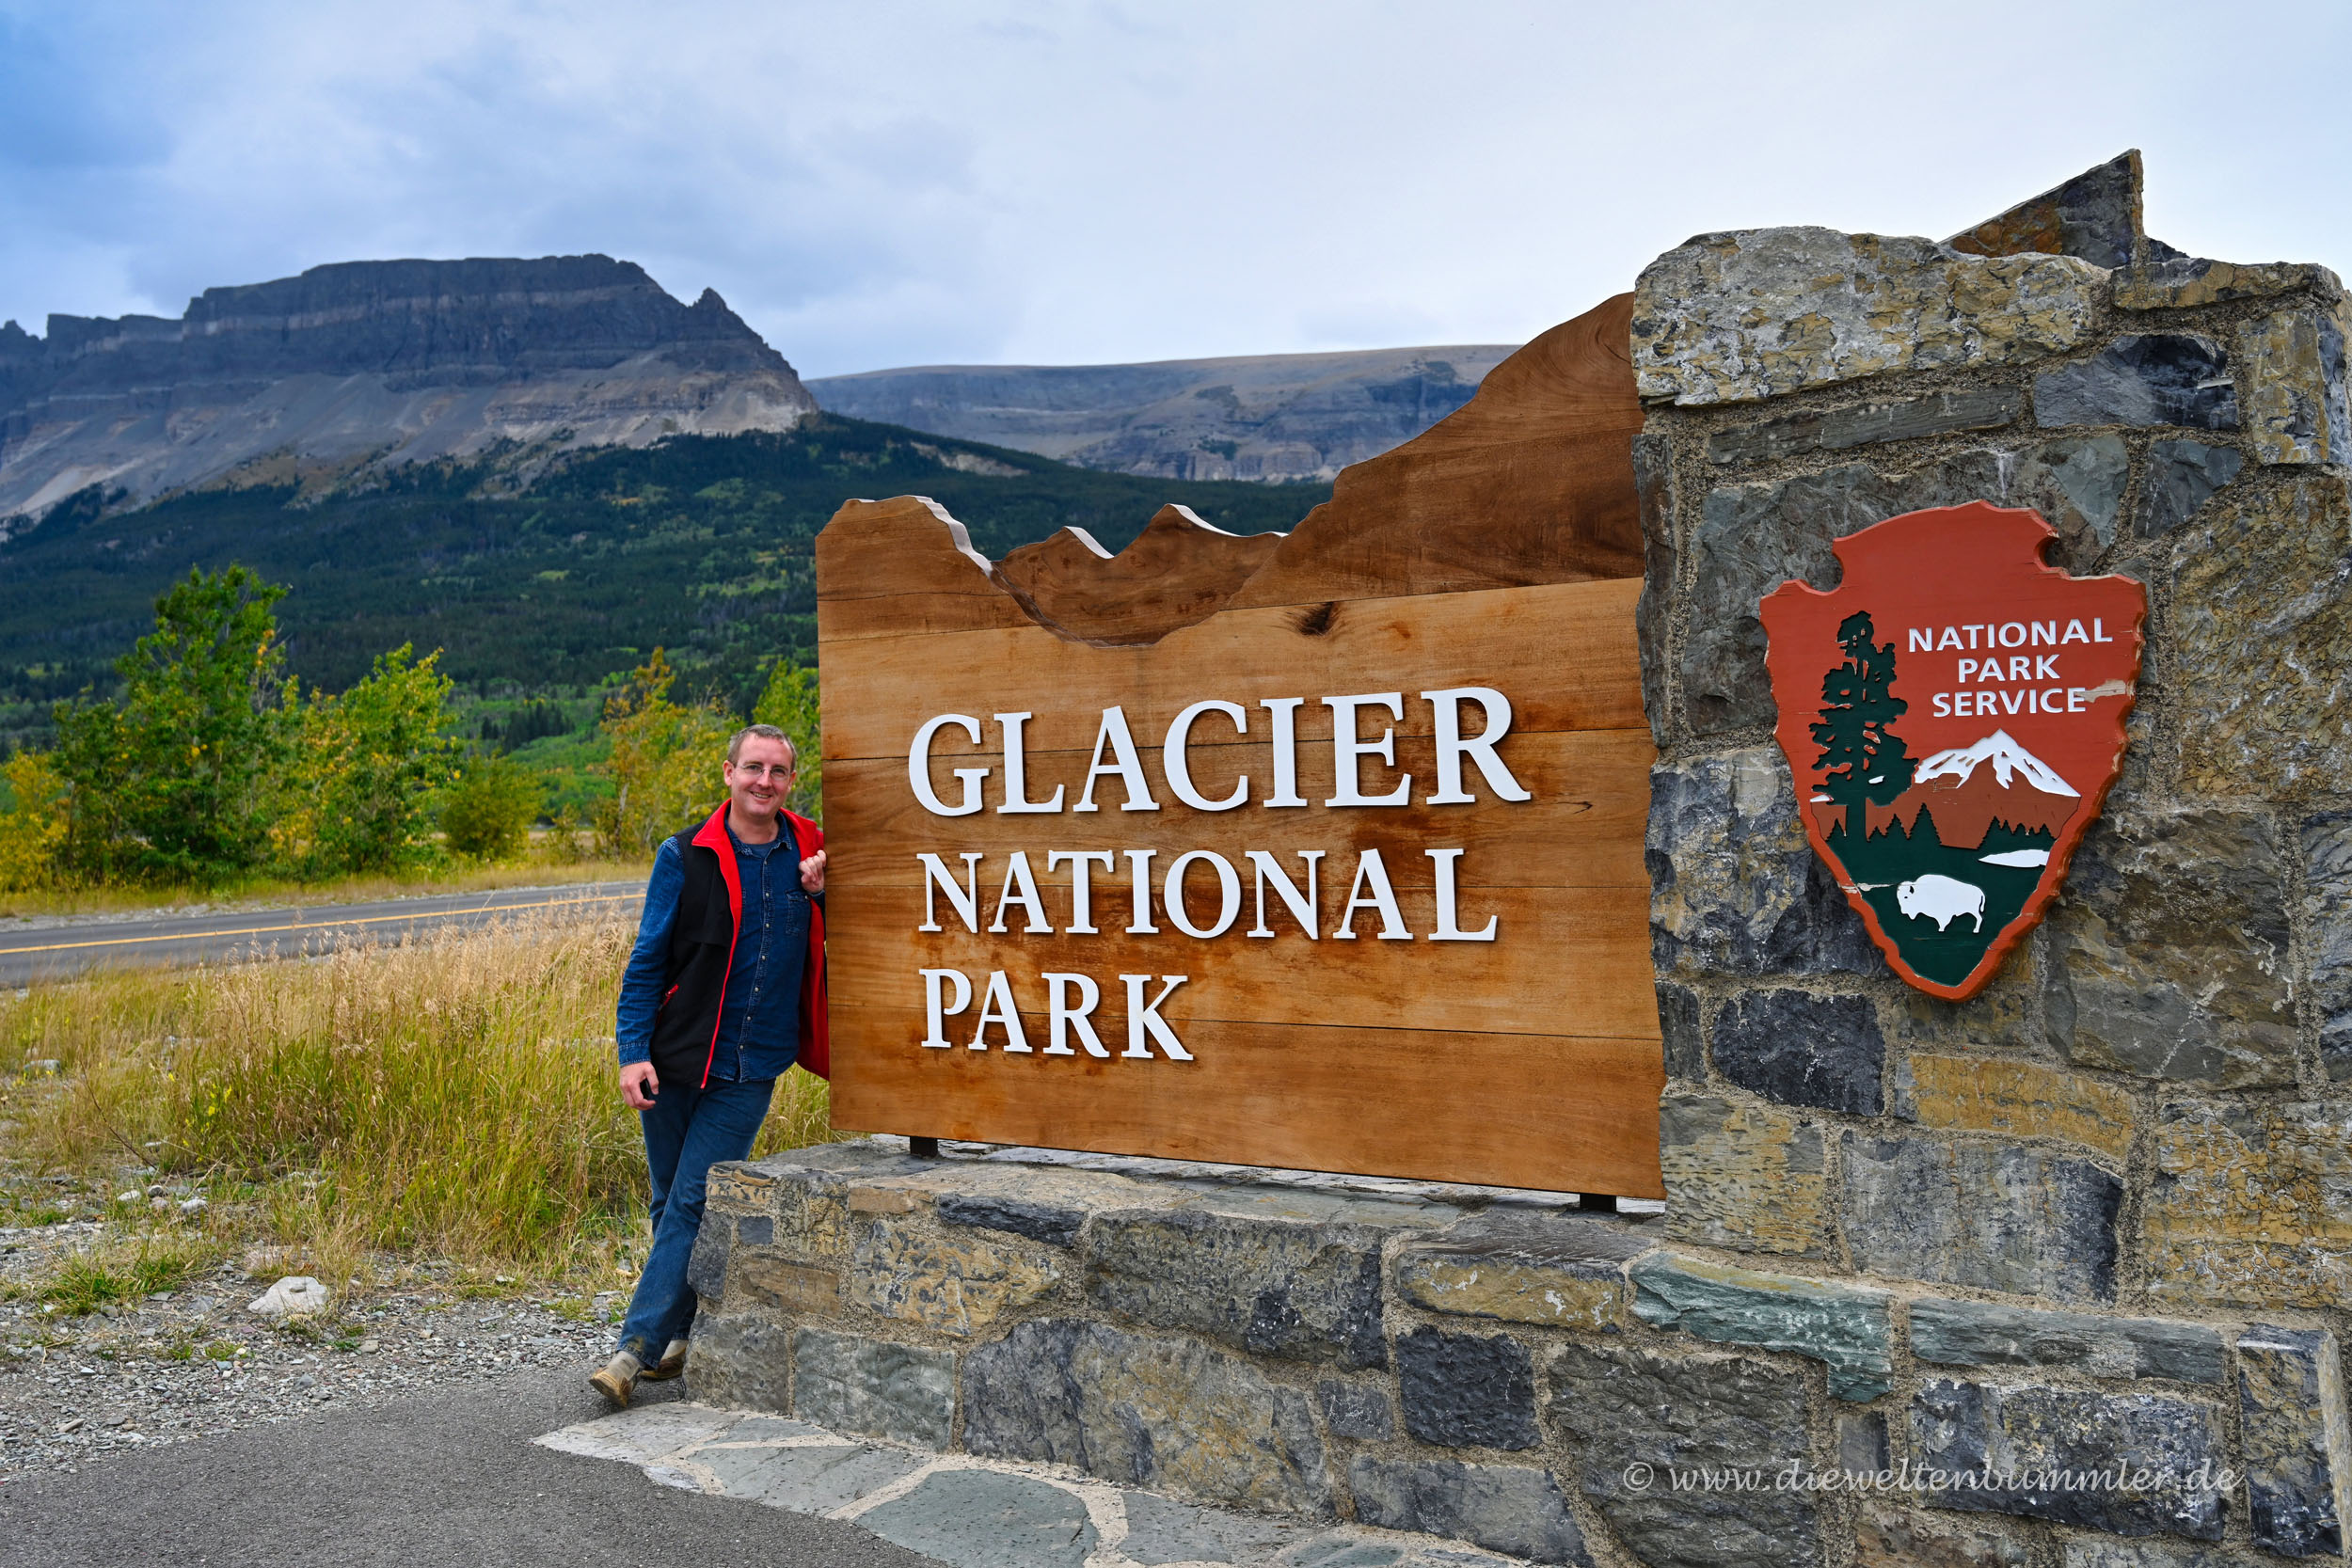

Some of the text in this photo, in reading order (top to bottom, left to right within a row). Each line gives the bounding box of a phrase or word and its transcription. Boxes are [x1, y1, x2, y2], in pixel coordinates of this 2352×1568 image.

[1908, 617, 2114, 653] NATIONAL
[1958, 654, 2060, 683] PARK
[1932, 687, 2087, 718] SERVICE
[908, 687, 1533, 816] GLACIER
[916, 848, 1499, 942] NATIONAL
[918, 969, 1194, 1061] PARK
